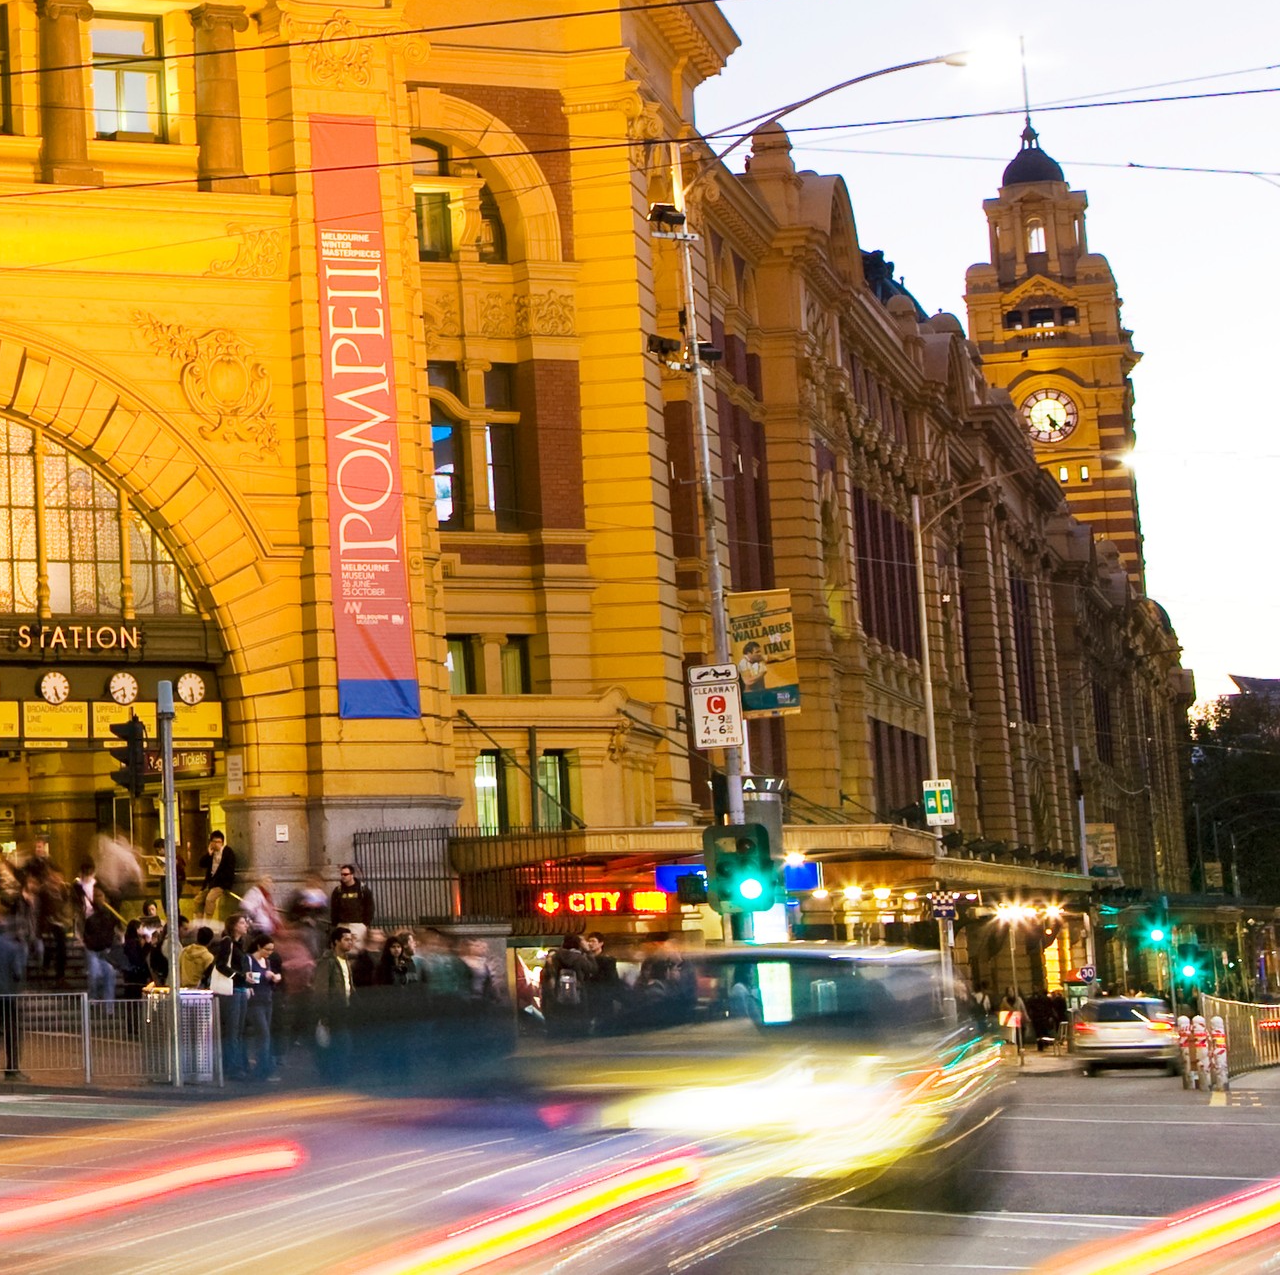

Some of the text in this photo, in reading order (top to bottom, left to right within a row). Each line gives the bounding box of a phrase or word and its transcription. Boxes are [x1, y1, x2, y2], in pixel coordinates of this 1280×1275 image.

[321, 232, 370, 242] MELBOURNE
[321, 240, 352, 249] WINTER
[321, 248, 381, 259] MASTERPIECES
[325, 263, 397, 558] POMPEII
[341, 564, 390, 572] MELBOURNE
[342, 572, 376, 580] MUSEUM
[342, 588, 386, 596] 25 OCTOBER
[18, 625, 139, 649] STATION
[732, 622, 792, 643] WALLABIES
[763, 640, 792, 655] ITALY
[693, 686, 736, 696] CLEARWAY
[27, 705, 83, 713] BROADMEADOWS
[710, 696, 722, 713] C
[27, 715, 42, 723] LINE
[96, 716, 110, 724] LINE
[180, 752, 208, 767] Tickets
[568, 892, 620, 912] CITY
[1081, 968, 1094, 978] 30
